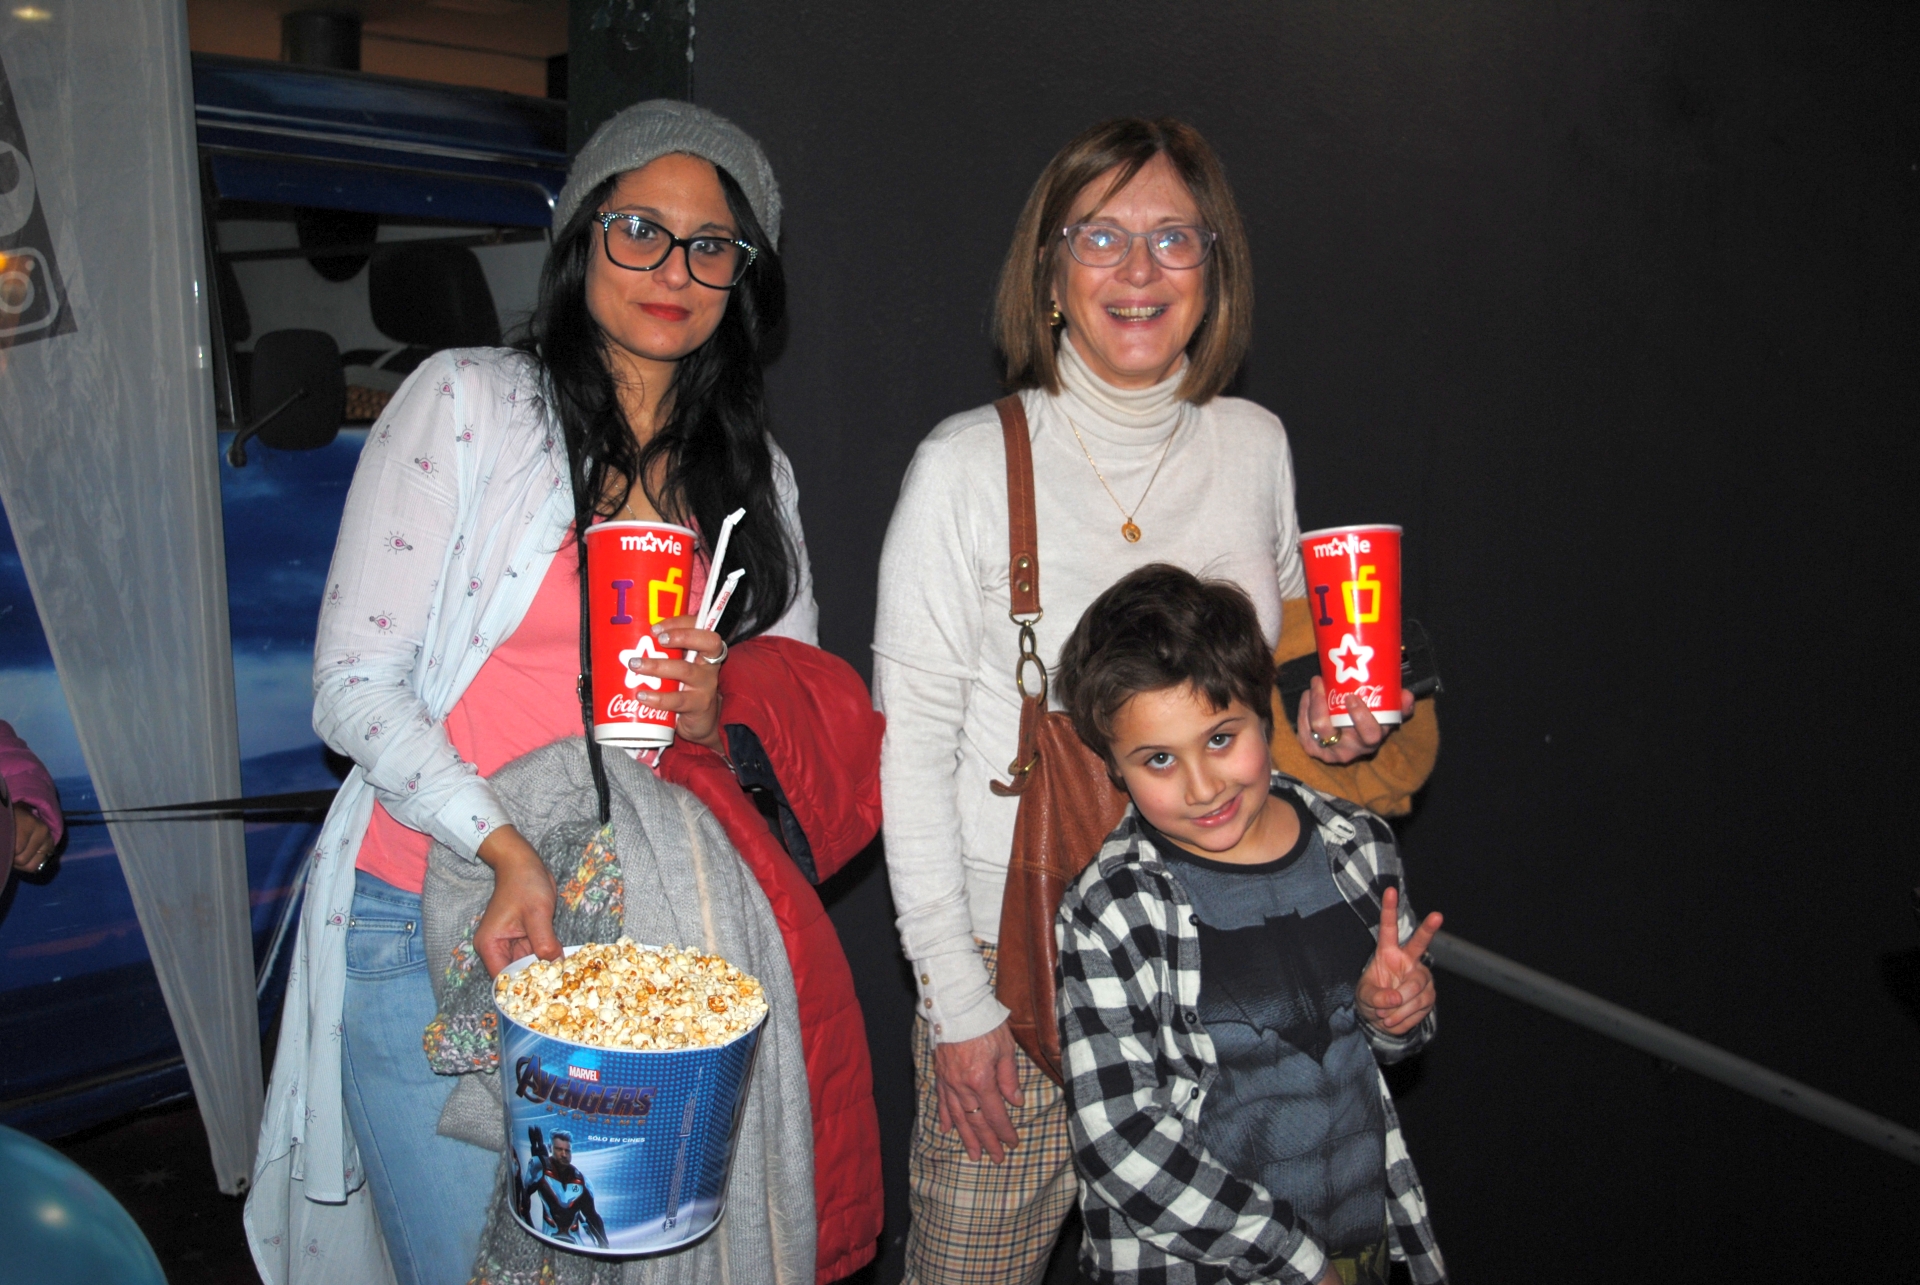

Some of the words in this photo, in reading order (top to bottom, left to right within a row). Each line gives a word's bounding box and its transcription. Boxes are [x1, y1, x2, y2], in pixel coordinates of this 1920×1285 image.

[1327, 685, 1384, 711] CocCola
[568, 1065, 599, 1082] MARVEL
[515, 1054, 657, 1117] AVENGERS
[587, 1134, 608, 1143] SÓLO
[609, 1136, 621, 1144] EN
